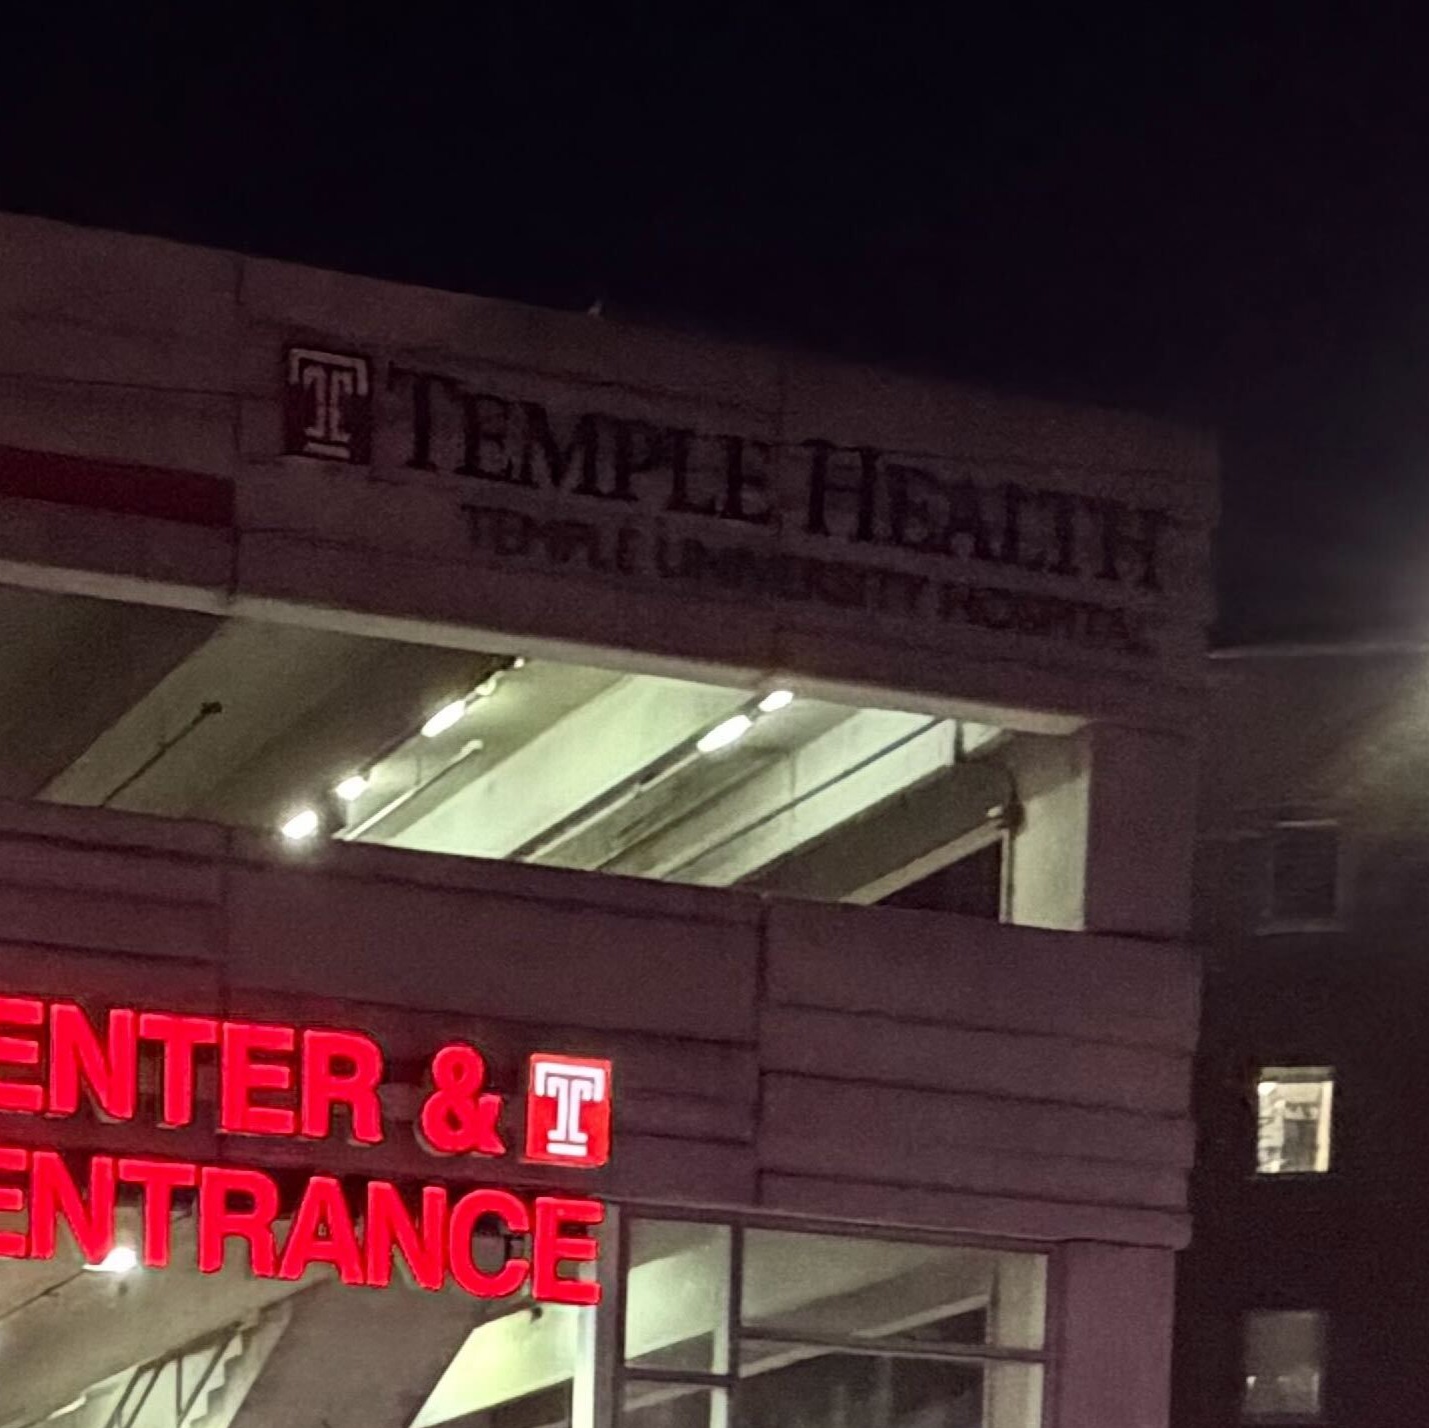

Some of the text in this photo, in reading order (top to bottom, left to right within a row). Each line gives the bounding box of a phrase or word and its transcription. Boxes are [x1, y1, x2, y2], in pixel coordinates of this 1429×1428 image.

[388, 361, 1169, 588] TEMPLE HEALTH
[420, 1042, 506, 1157] &
